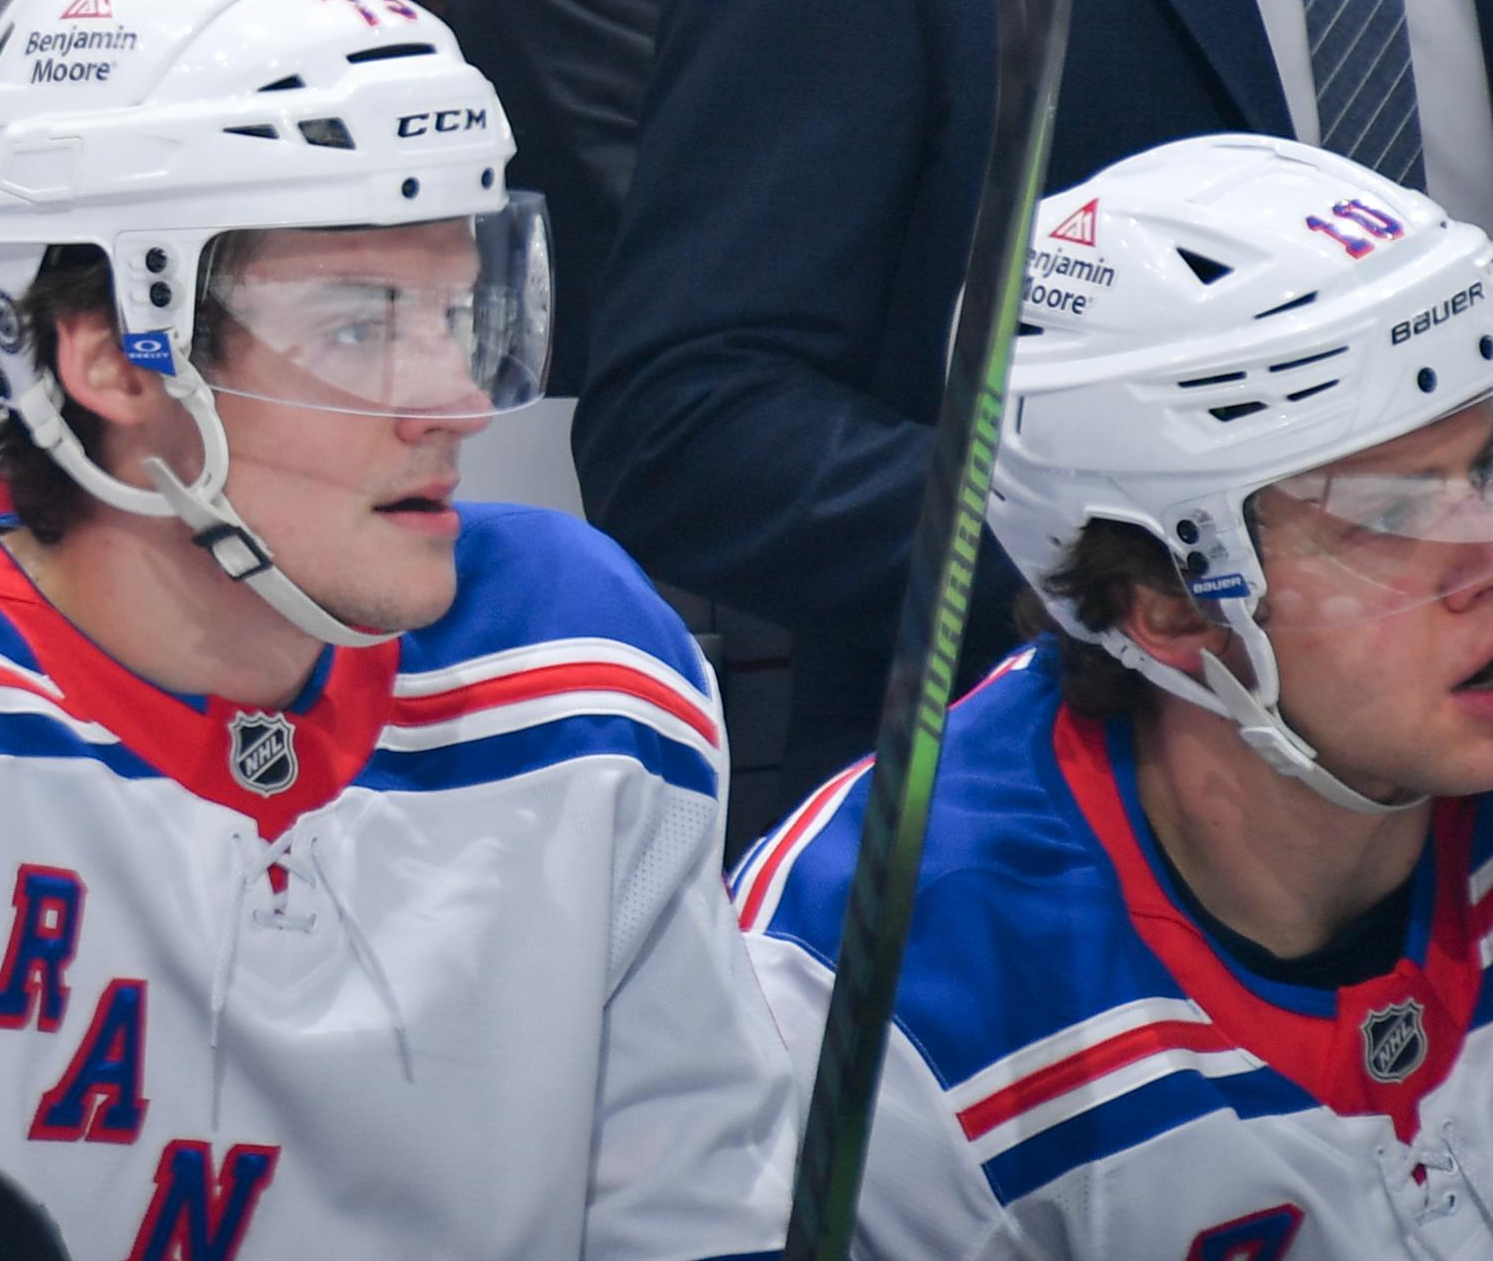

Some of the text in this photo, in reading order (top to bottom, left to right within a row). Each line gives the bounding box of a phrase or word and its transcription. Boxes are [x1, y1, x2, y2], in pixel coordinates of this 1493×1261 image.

[25, 25, 137, 57] Benjamin
[30, 58, 111, 84] Moore
[396, 108, 488, 139] CCM
[1305, 199, 1405, 260] 10
[1026, 246, 1115, 287] enjamin
[1390, 281, 1485, 346] BAUER
[919, 388, 1003, 735] WARRIOR
[245, 734, 283, 777] NHL
[1379, 1021, 1413, 1070] NHL
